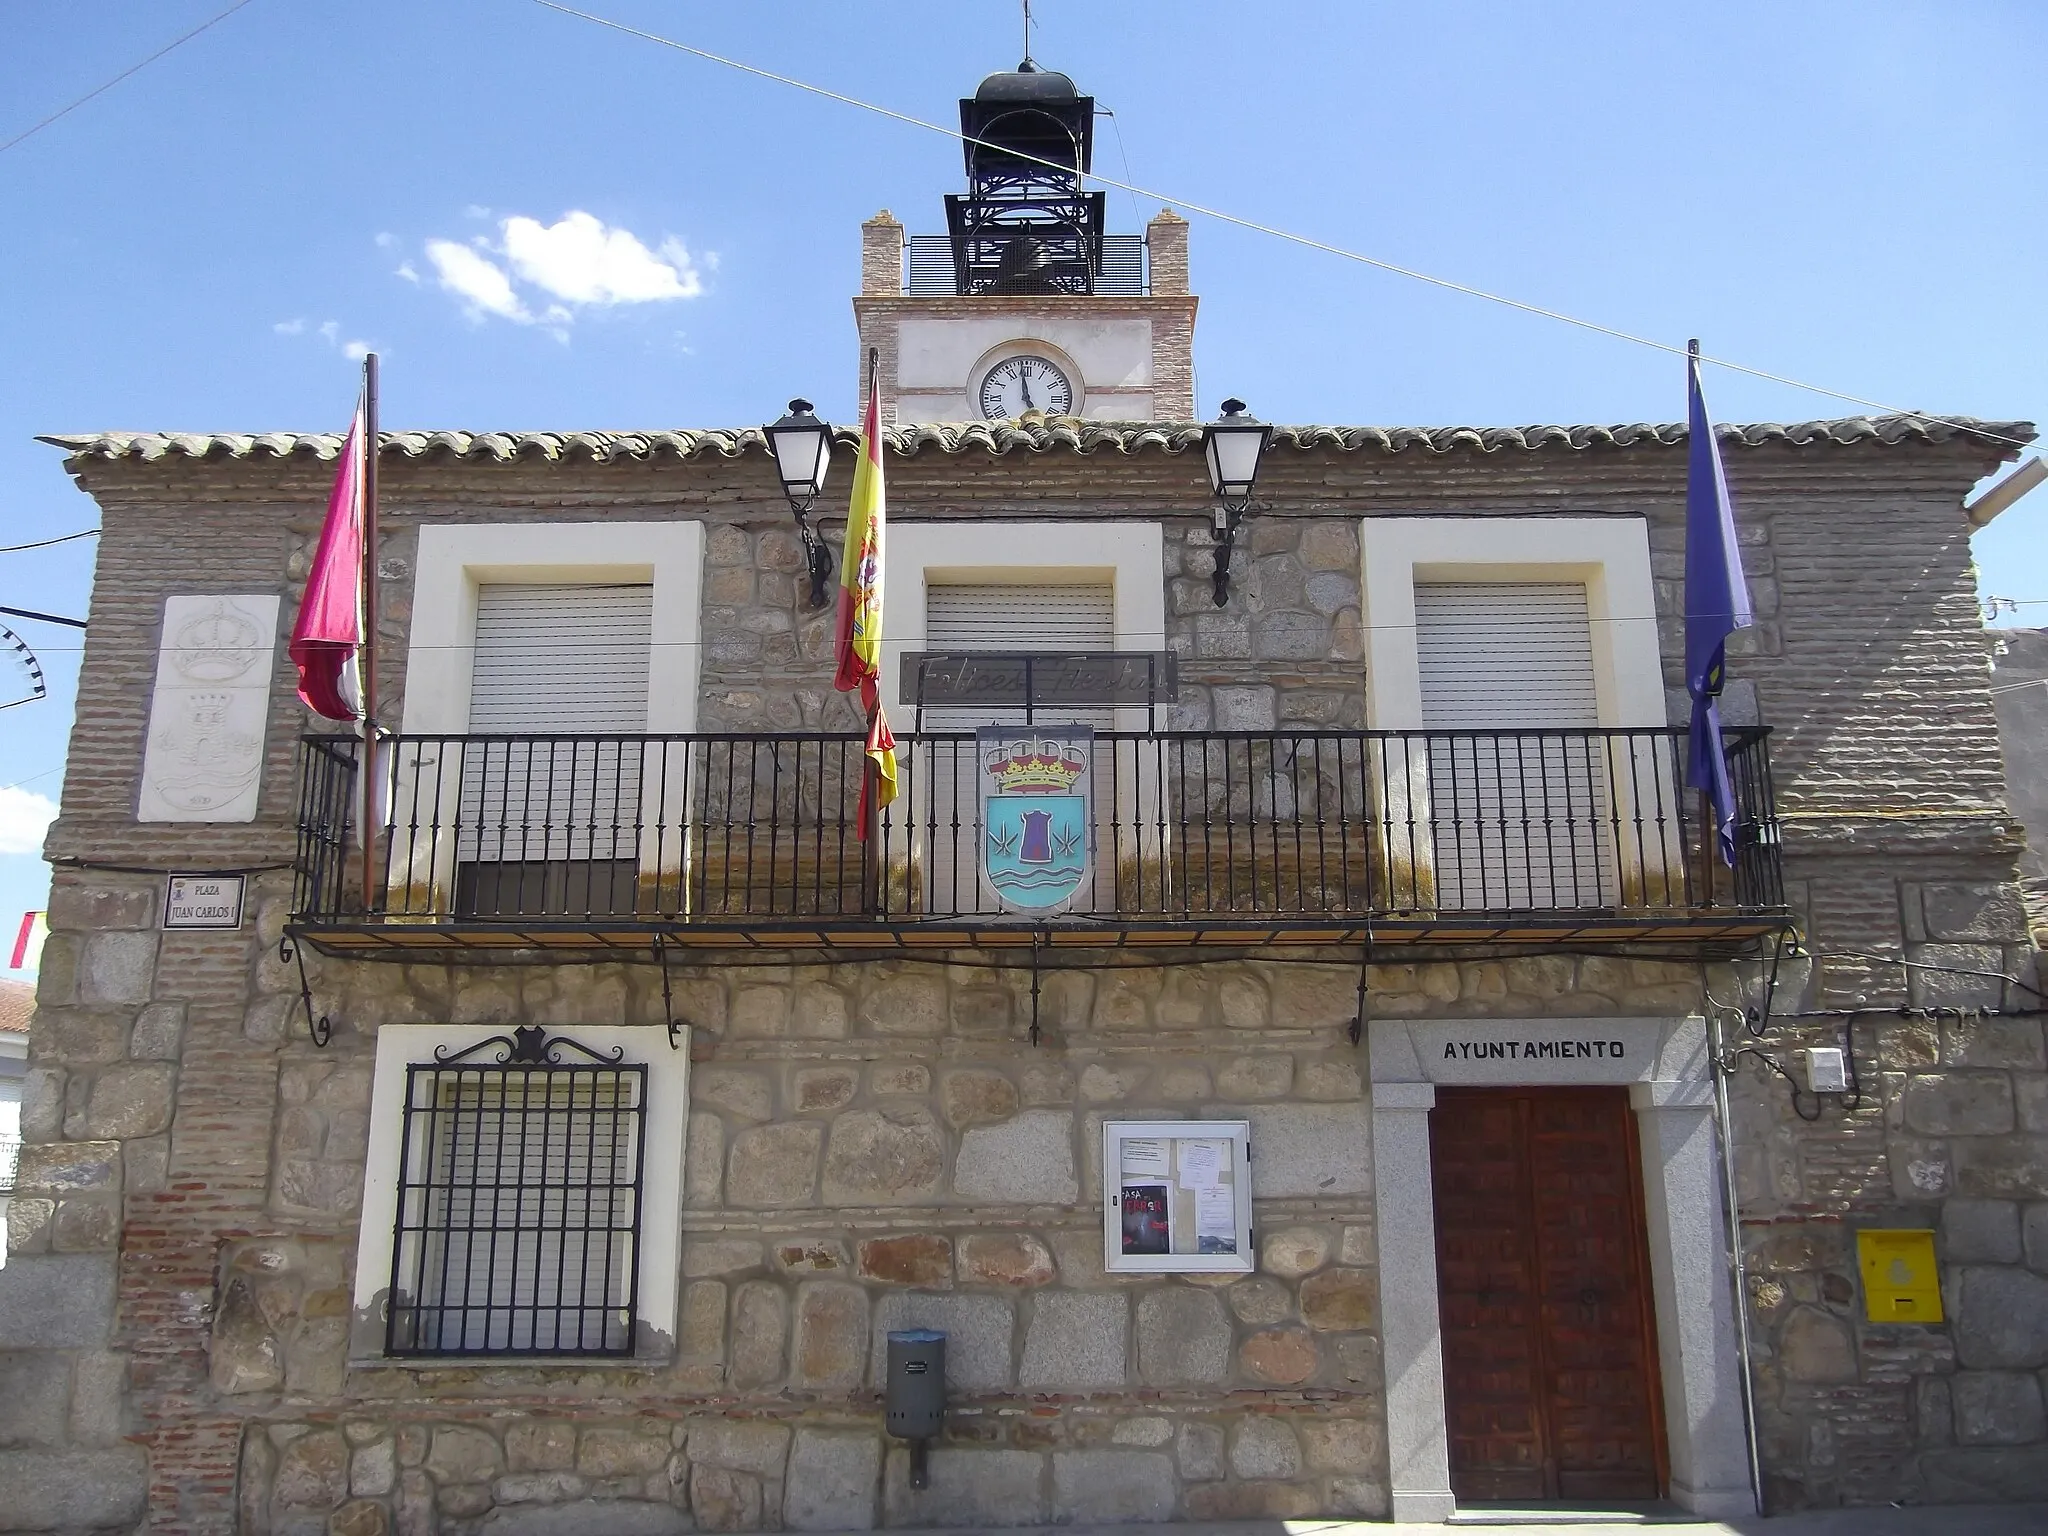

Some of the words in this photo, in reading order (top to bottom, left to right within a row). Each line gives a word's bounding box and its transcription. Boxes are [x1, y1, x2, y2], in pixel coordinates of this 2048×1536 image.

[1050, 395, 1063, 404] III
[194, 885, 220, 895] PLAZA
[171, 906, 194, 920] JUAN
[195, 906, 229, 918] CARLOS
[1443, 1041, 1625, 1059] AYUNTAMIENTO
[1122, 1189, 1142, 1200] ASA
